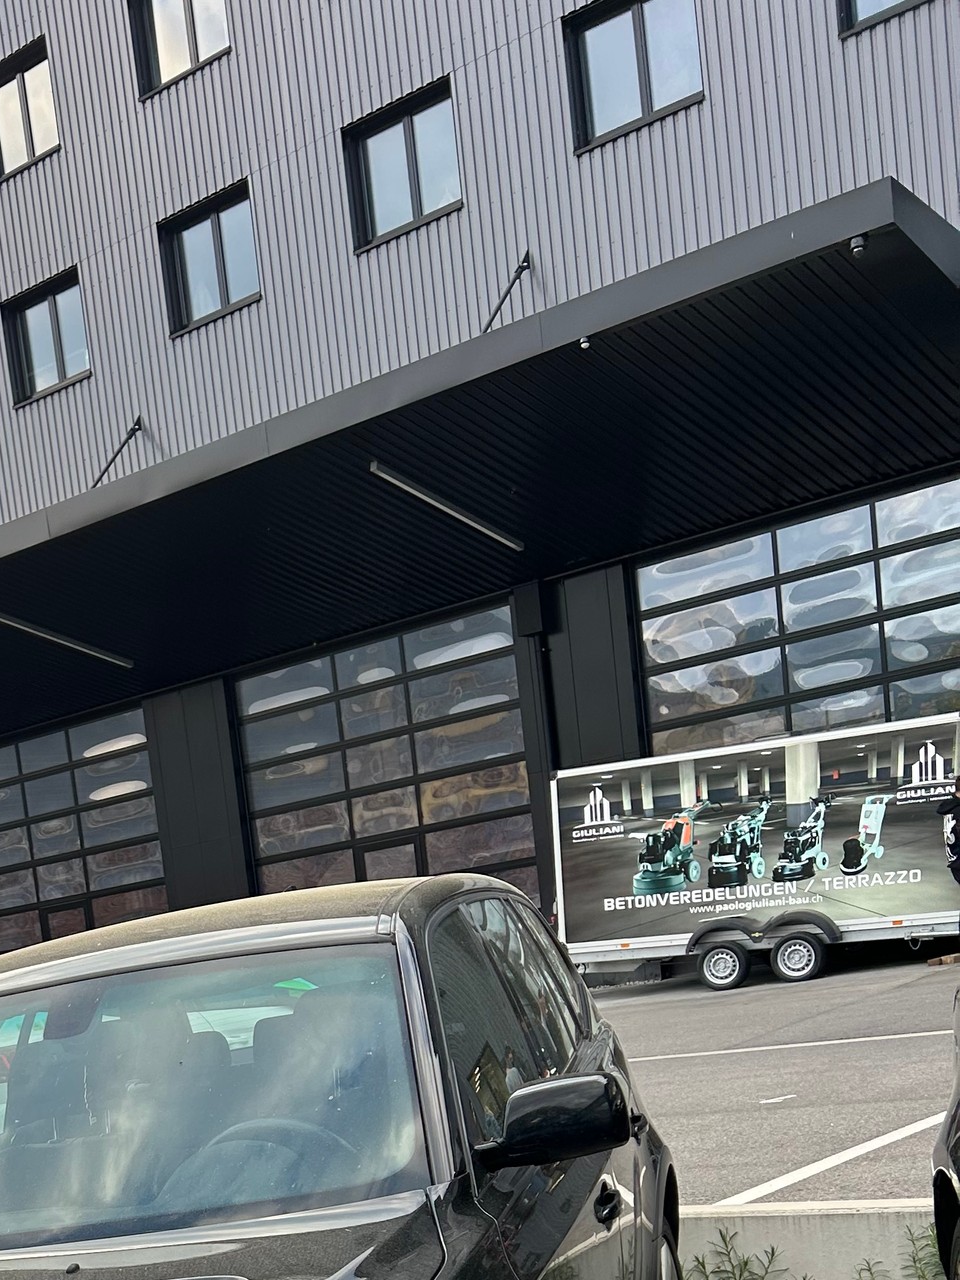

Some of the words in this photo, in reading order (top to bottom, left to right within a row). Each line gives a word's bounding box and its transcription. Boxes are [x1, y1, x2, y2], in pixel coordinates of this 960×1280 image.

[896, 785, 956, 799] GIULIAN
[572, 825, 624, 838] GIULIANI
[603, 881, 797, 911] BETONVEREDELUNGEN
[822, 869, 922, 891] TERRAZZO
[689, 894, 823, 914] www.paologiuliani-bau.ch
